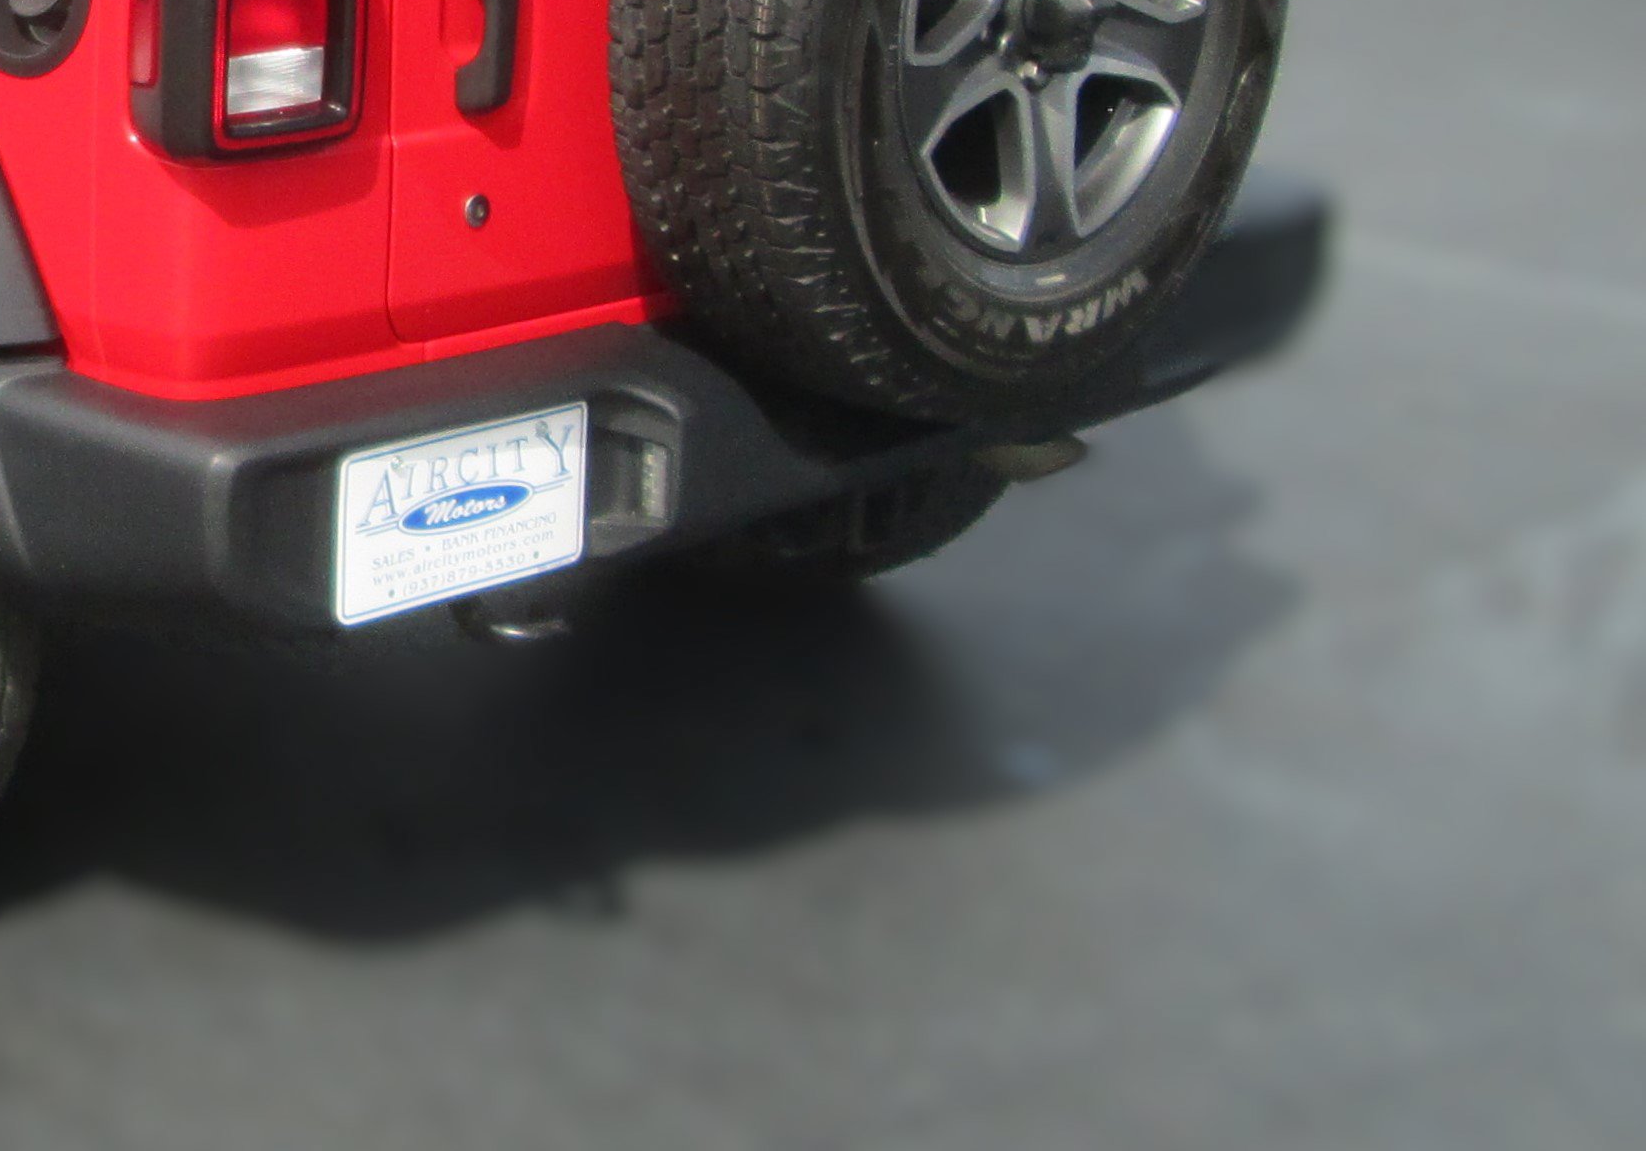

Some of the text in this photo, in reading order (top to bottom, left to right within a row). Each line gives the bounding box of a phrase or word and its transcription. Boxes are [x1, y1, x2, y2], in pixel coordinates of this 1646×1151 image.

[356, 423, 575, 527] AIRCITY
[424, 495, 507, 525] Motors
[372, 511, 557, 570] SALES BANK FINANCING
[372, 529, 554, 587] www.aircitymotors.com
